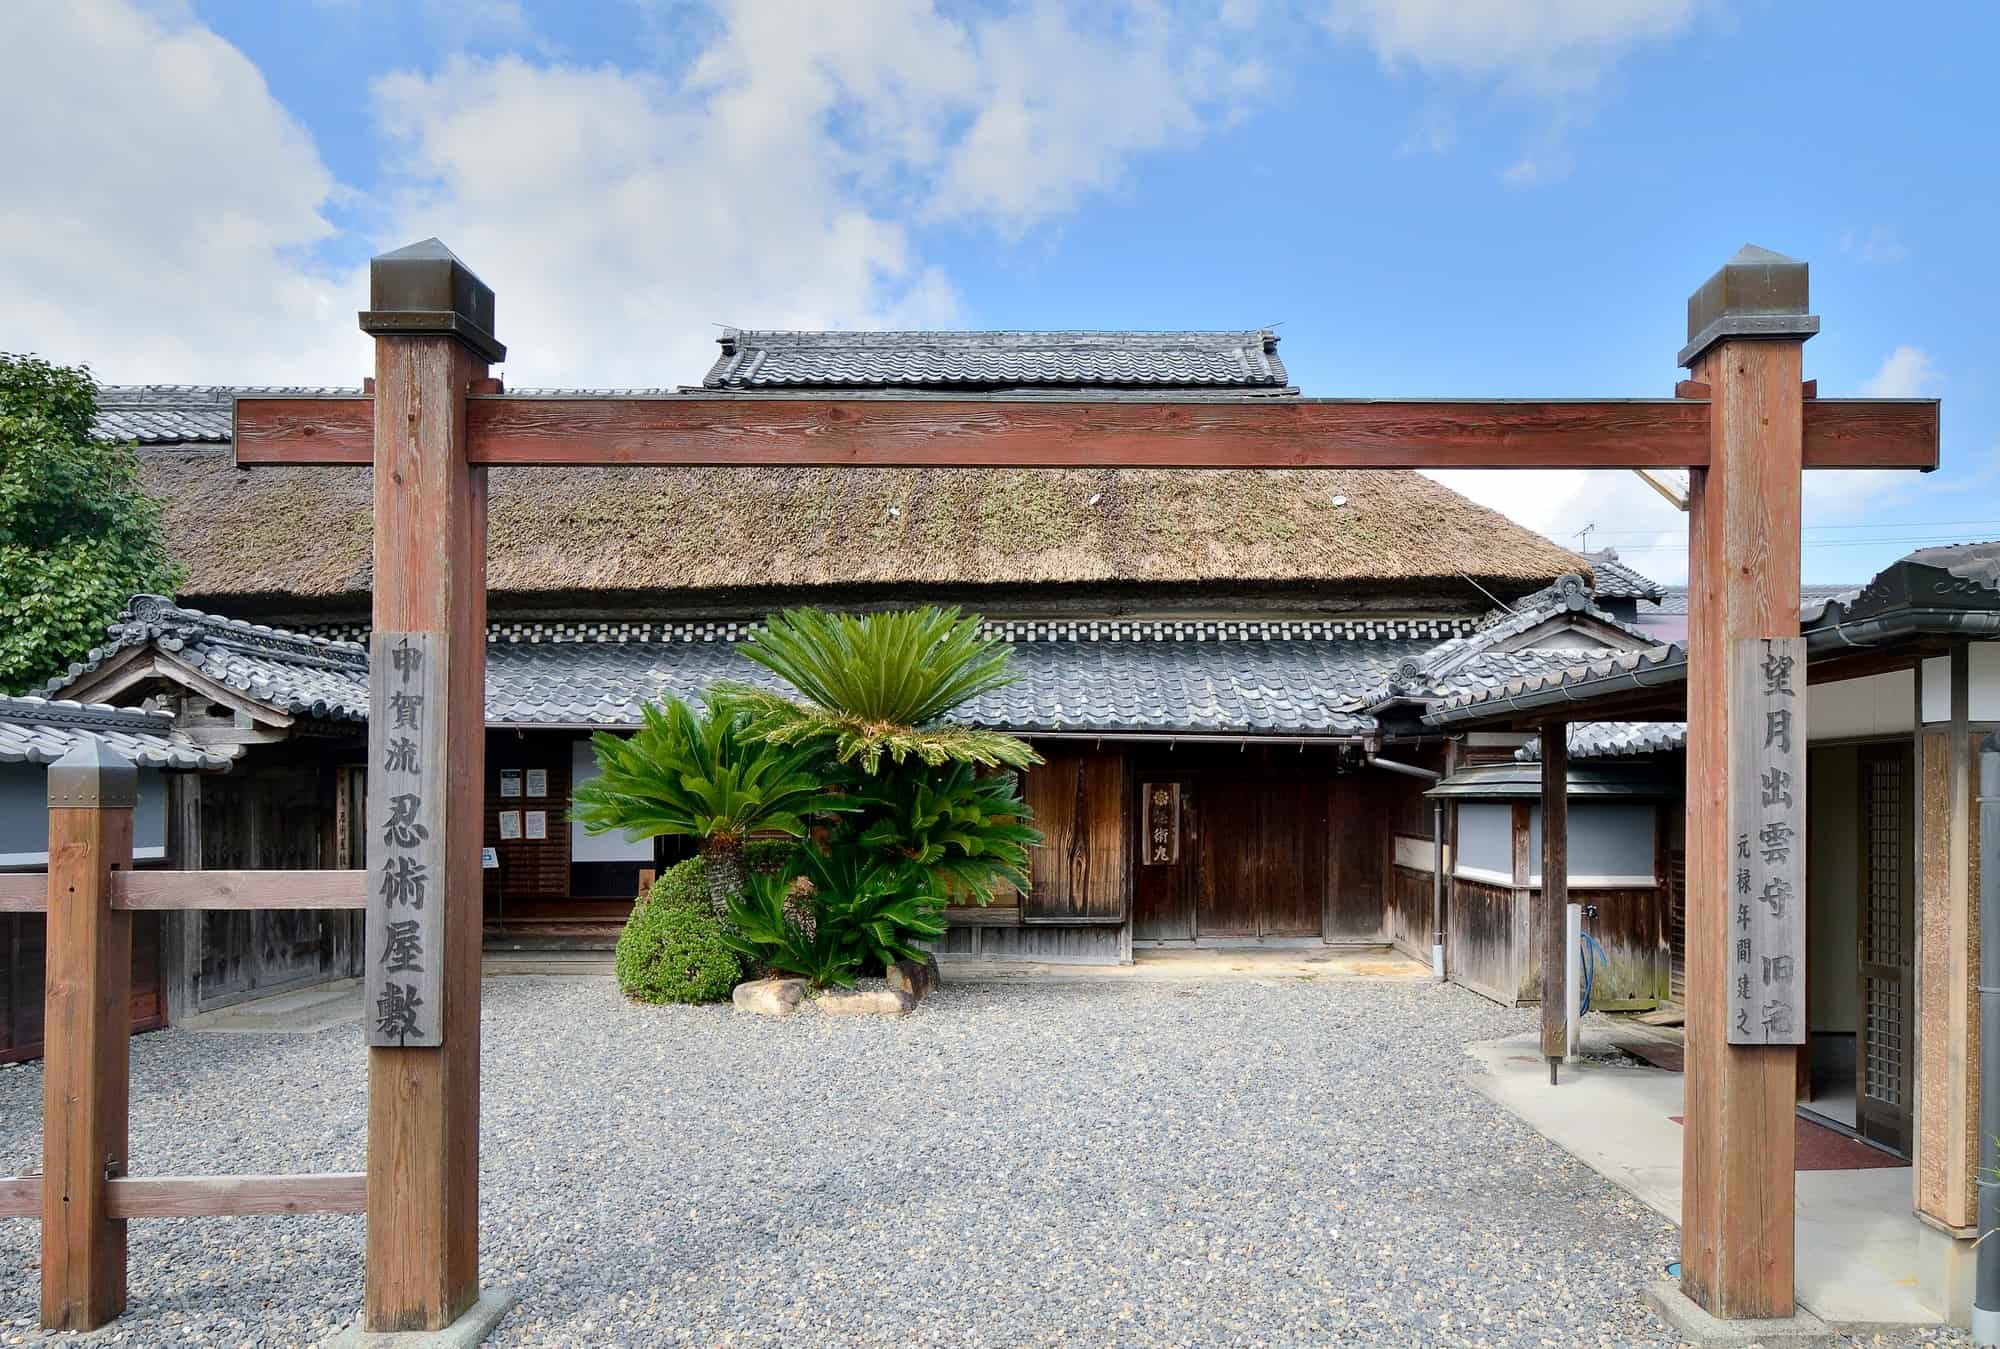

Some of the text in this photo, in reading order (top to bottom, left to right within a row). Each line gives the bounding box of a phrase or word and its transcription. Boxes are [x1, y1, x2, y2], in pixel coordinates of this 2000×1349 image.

[376, 646, 430, 1039] 甲賀流忍術屋敷
